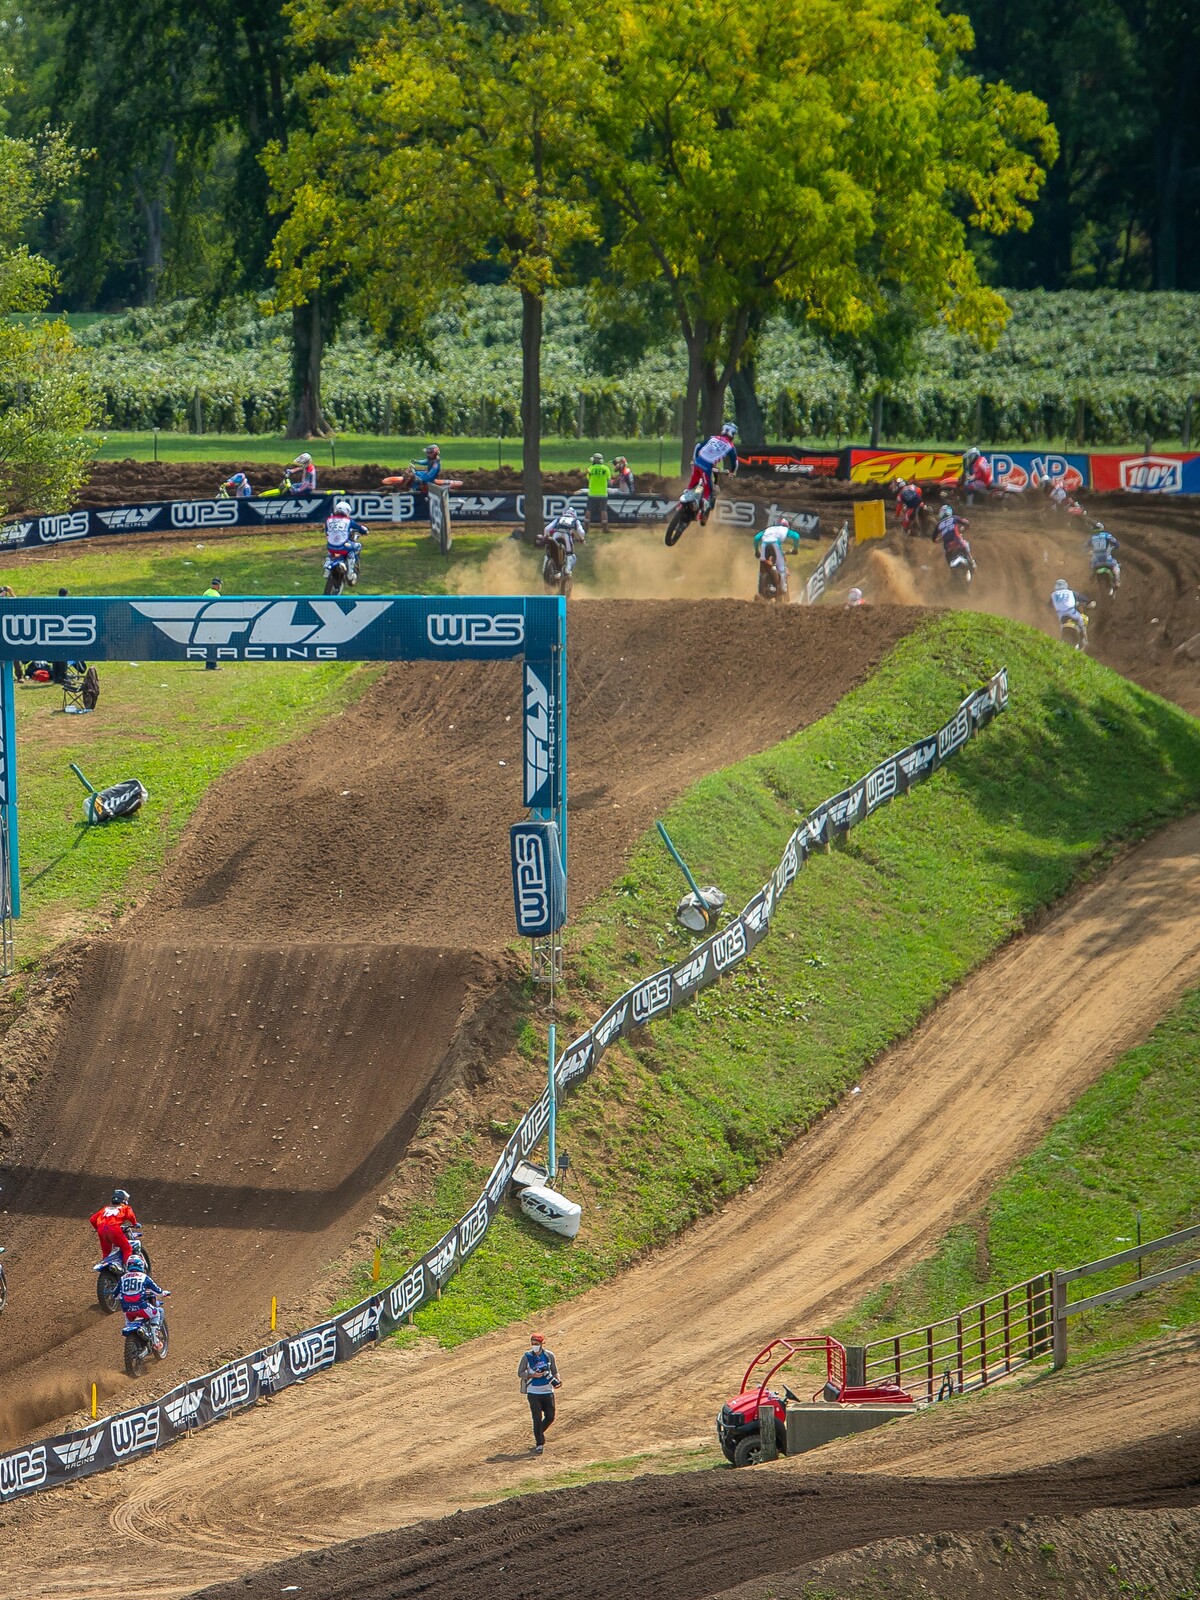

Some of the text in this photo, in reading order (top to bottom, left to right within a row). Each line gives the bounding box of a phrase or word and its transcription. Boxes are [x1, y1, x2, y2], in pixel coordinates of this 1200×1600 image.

[737, 456, 839, 466] NTENSE
[851, 455, 964, 484] FMF
[1129, 464, 1176, 486] 100%
[96, 507, 163, 524] FLY
[171, 500, 239, 528] WPS
[248, 499, 324, 515] FLY
[608, 499, 679, 515] FLY
[39, 511, 89, 542] WPS
[108, 521, 148, 529] RACING
[2, 614, 96, 646] WPS
[128, 601, 394, 644] FLY
[427, 614, 524, 646] WPS
[186, 647, 338, 659] RACING
[526, 664, 549, 804] FLY
[548, 694, 556, 775] RACING
[939, 708, 968, 759] WPS
[899, 743, 936, 774] FLY
[866, 761, 897, 808] WPS
[828, 787, 864, 822] FLY
[515, 833, 549, 927] WPS
[712, 922, 746, 970] WPS
[673, 950, 709, 986] FLY
[632, 973, 671, 1021] WPS
[460, 1199, 488, 1256] WPS
[427, 1235, 457, 1275] FLY
[390, 1264, 425, 1320] WPS
[341, 1299, 385, 1338] FLY
[351, 1325, 380, 1344] RACING
[288, 1325, 337, 1376] WPS
[164, 1387, 205, 1422] FLY
[210, 1362, 250, 1412] WPS
[110, 1406, 160, 1457] WPS
[173, 1411, 197, 1428] RACING
[52, 1430, 104, 1465] FLY
[65, 1455, 95, 1470] RACING
[0, 1446, 47, 1495] WPS
